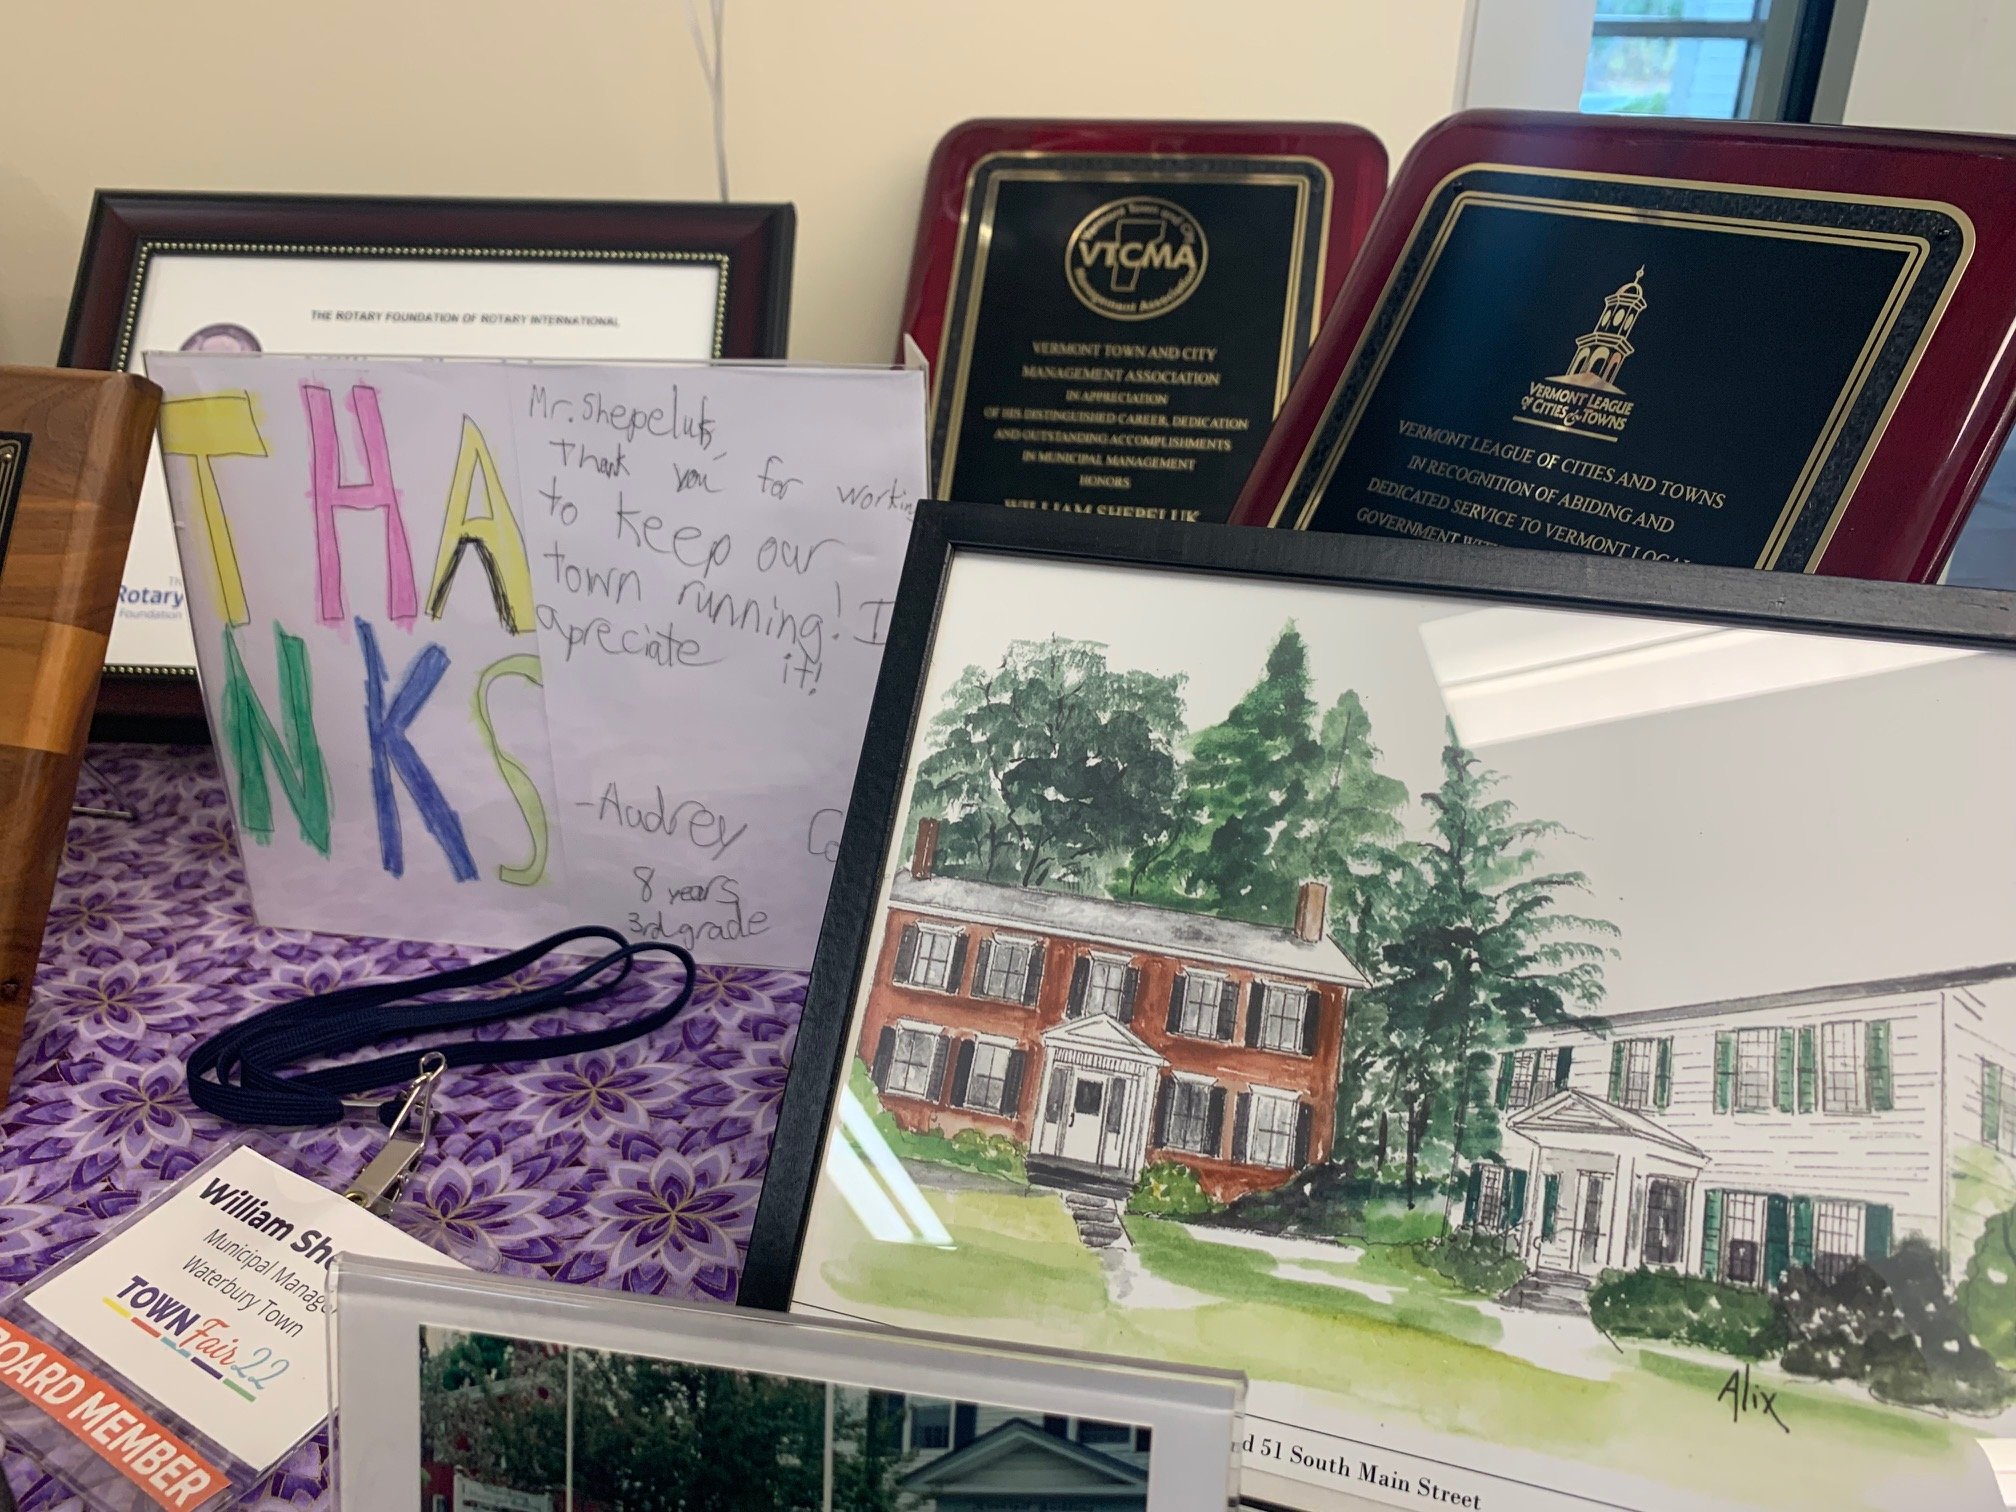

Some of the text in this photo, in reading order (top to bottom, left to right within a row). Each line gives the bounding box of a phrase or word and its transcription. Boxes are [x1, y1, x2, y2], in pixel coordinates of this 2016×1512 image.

[1078, 241, 1198, 269] VTCMA
[311, 309, 620, 327] THE ROTARY FOUNDATION OF ROTARY INTERNATIONAL
[1033, 341, 1218, 362] VERMONT TOWN AND CITY
[1022, 365, 1221, 386] MANAGEMENT ASSOCIATION
[529, 384, 574, 424] Mr.
[1066, 389, 1169, 405] IN APPRECIATION
[1529, 381, 1635, 416] VERMONT LEAGUE
[1532, 399, 1569, 419] CITIES
[1581, 408, 1628, 431] TOWNS
[984, 406, 998, 418] OF
[1001, 407, 1022, 420] HIS
[1024, 408, 1116, 424] DISTINGUISHED
[1172, 415, 1249, 431] DEDICATION
[993, 427, 1232, 451] AND OUTSTANDING ACCOMPLISHMENTS
[758, 456, 804, 499] for
[1022, 450, 1196, 472] IN MUNICIPAL MANAGEMENT
[1399, 419, 1727, 509] VERMONT LEAGUE OF CITIES AND TOWNS
[1079, 474, 1132, 489] HONORS
[1407, 455, 1675, 533] IN RECOGNITION OF ABIDING AND
[538, 476, 579, 526] to
[758, 538, 846, 575] our
[1356, 507, 1461, 544] GOVERNMENT
[1366, 477, 1450, 510] DEDICATED
[1451, 499, 1518, 529] SERVICE
[1519, 516, 1541, 535] TO
[1545, 523, 1631, 558] VERMONT
[120, 584, 183, 608] Rotary
[543, 541, 896, 664] town running! I
[632, 866, 741, 905] 8 years
[199, 1177, 295, 1242] William
[203, 1228, 280, 1276] Municipal
[182, 1255, 304, 1338] Waterbury Town
[116, 1275, 290, 1391] TOWN Fair 22
[1717, 1363, 1790, 1434] Alix
[66, 1390, 211, 1508] MEMBER
[1260, 1439, 1282, 1460] 51
[1289, 1445, 1351, 1478] South
[1357, 1461, 1410, 1493] Main
[1417, 1477, 1482, 1511] Street
